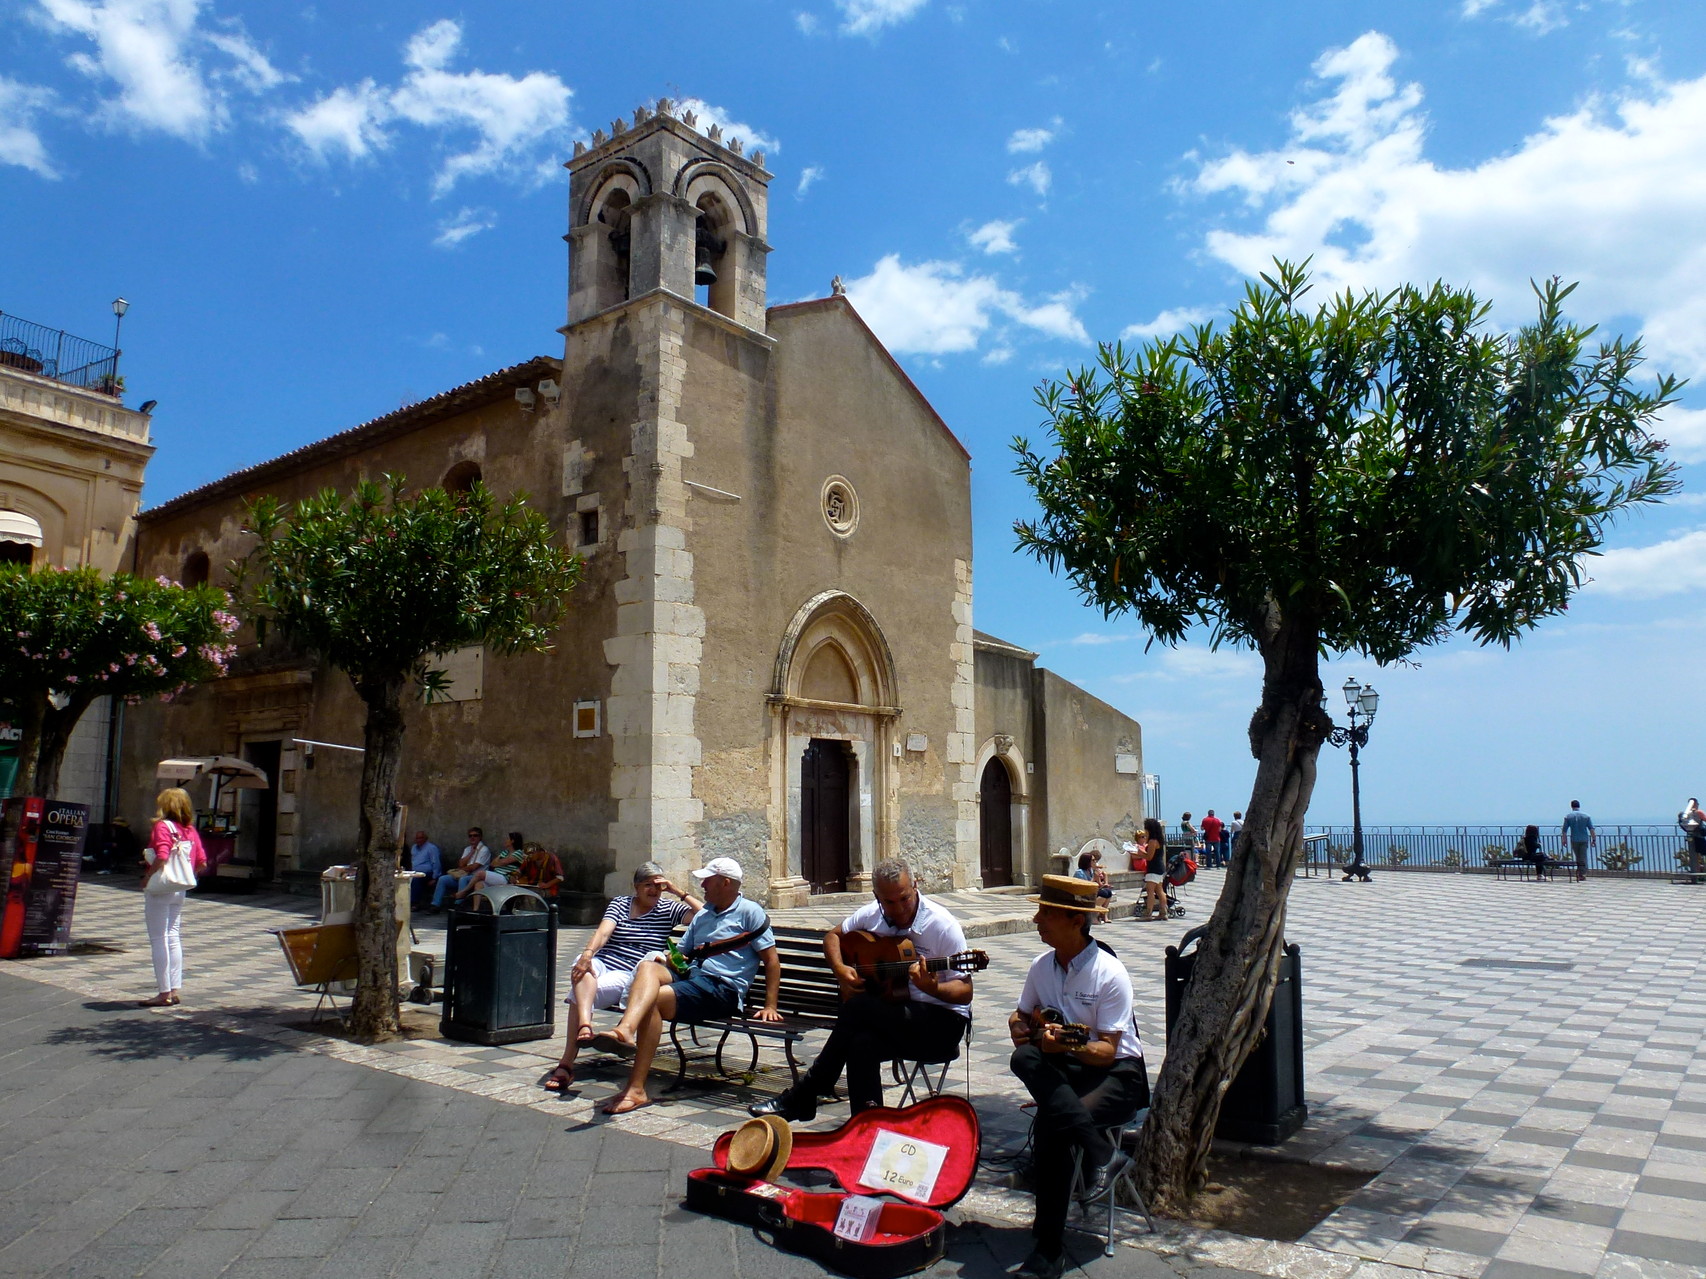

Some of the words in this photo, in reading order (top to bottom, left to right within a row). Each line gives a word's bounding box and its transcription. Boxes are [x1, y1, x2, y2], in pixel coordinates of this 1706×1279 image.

[48, 810, 84, 826] OPERA
[58, 808, 86, 816] ITALIAN
[901, 1143, 917, 1156] CD
[883, 1170, 898, 1182] 12
[898, 1176, 914, 1186] Euro
